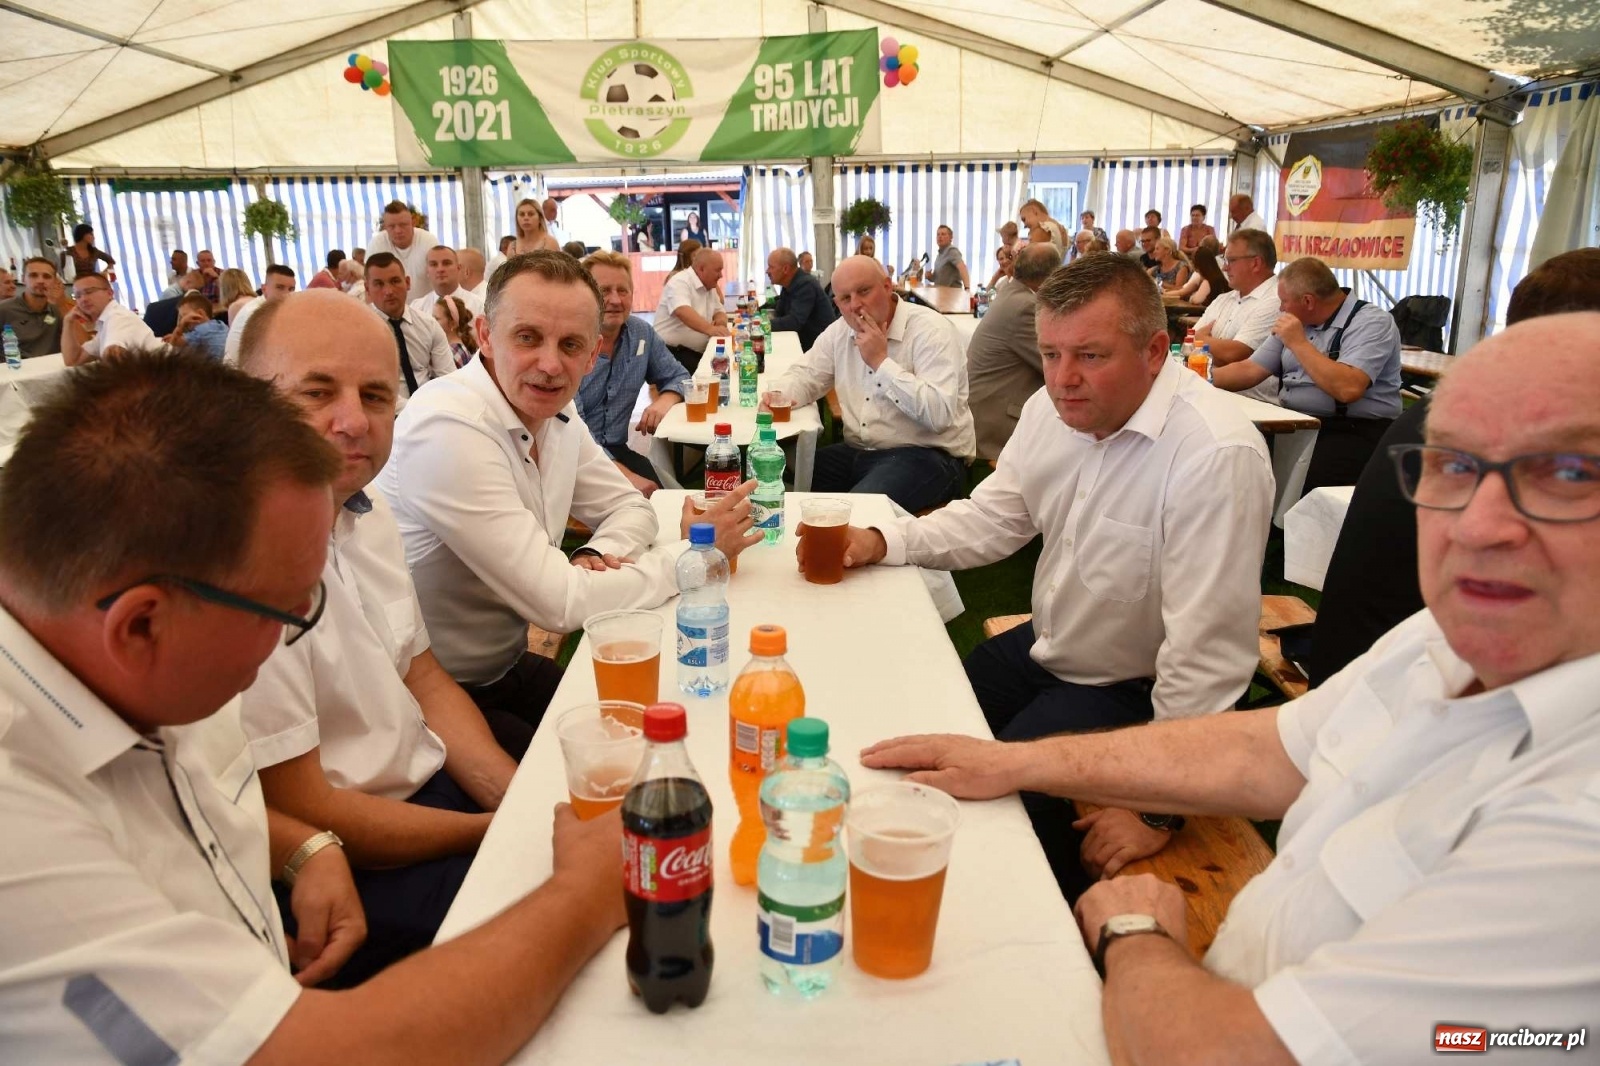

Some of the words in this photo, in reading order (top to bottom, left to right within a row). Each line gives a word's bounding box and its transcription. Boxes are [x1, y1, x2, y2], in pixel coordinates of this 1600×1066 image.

[439, 65, 499, 96] 1926
[587, 58, 613, 89] Klub
[618, 48, 685, 88] Sportowy
[754, 63, 795, 101] 95
[804, 56, 854, 96] LAT
[432, 100, 512, 141] 2021
[589, 105, 686, 116] Pietraszyn
[750, 97, 859, 132] TRADYCJI
[615, 140, 662, 154] 1926
